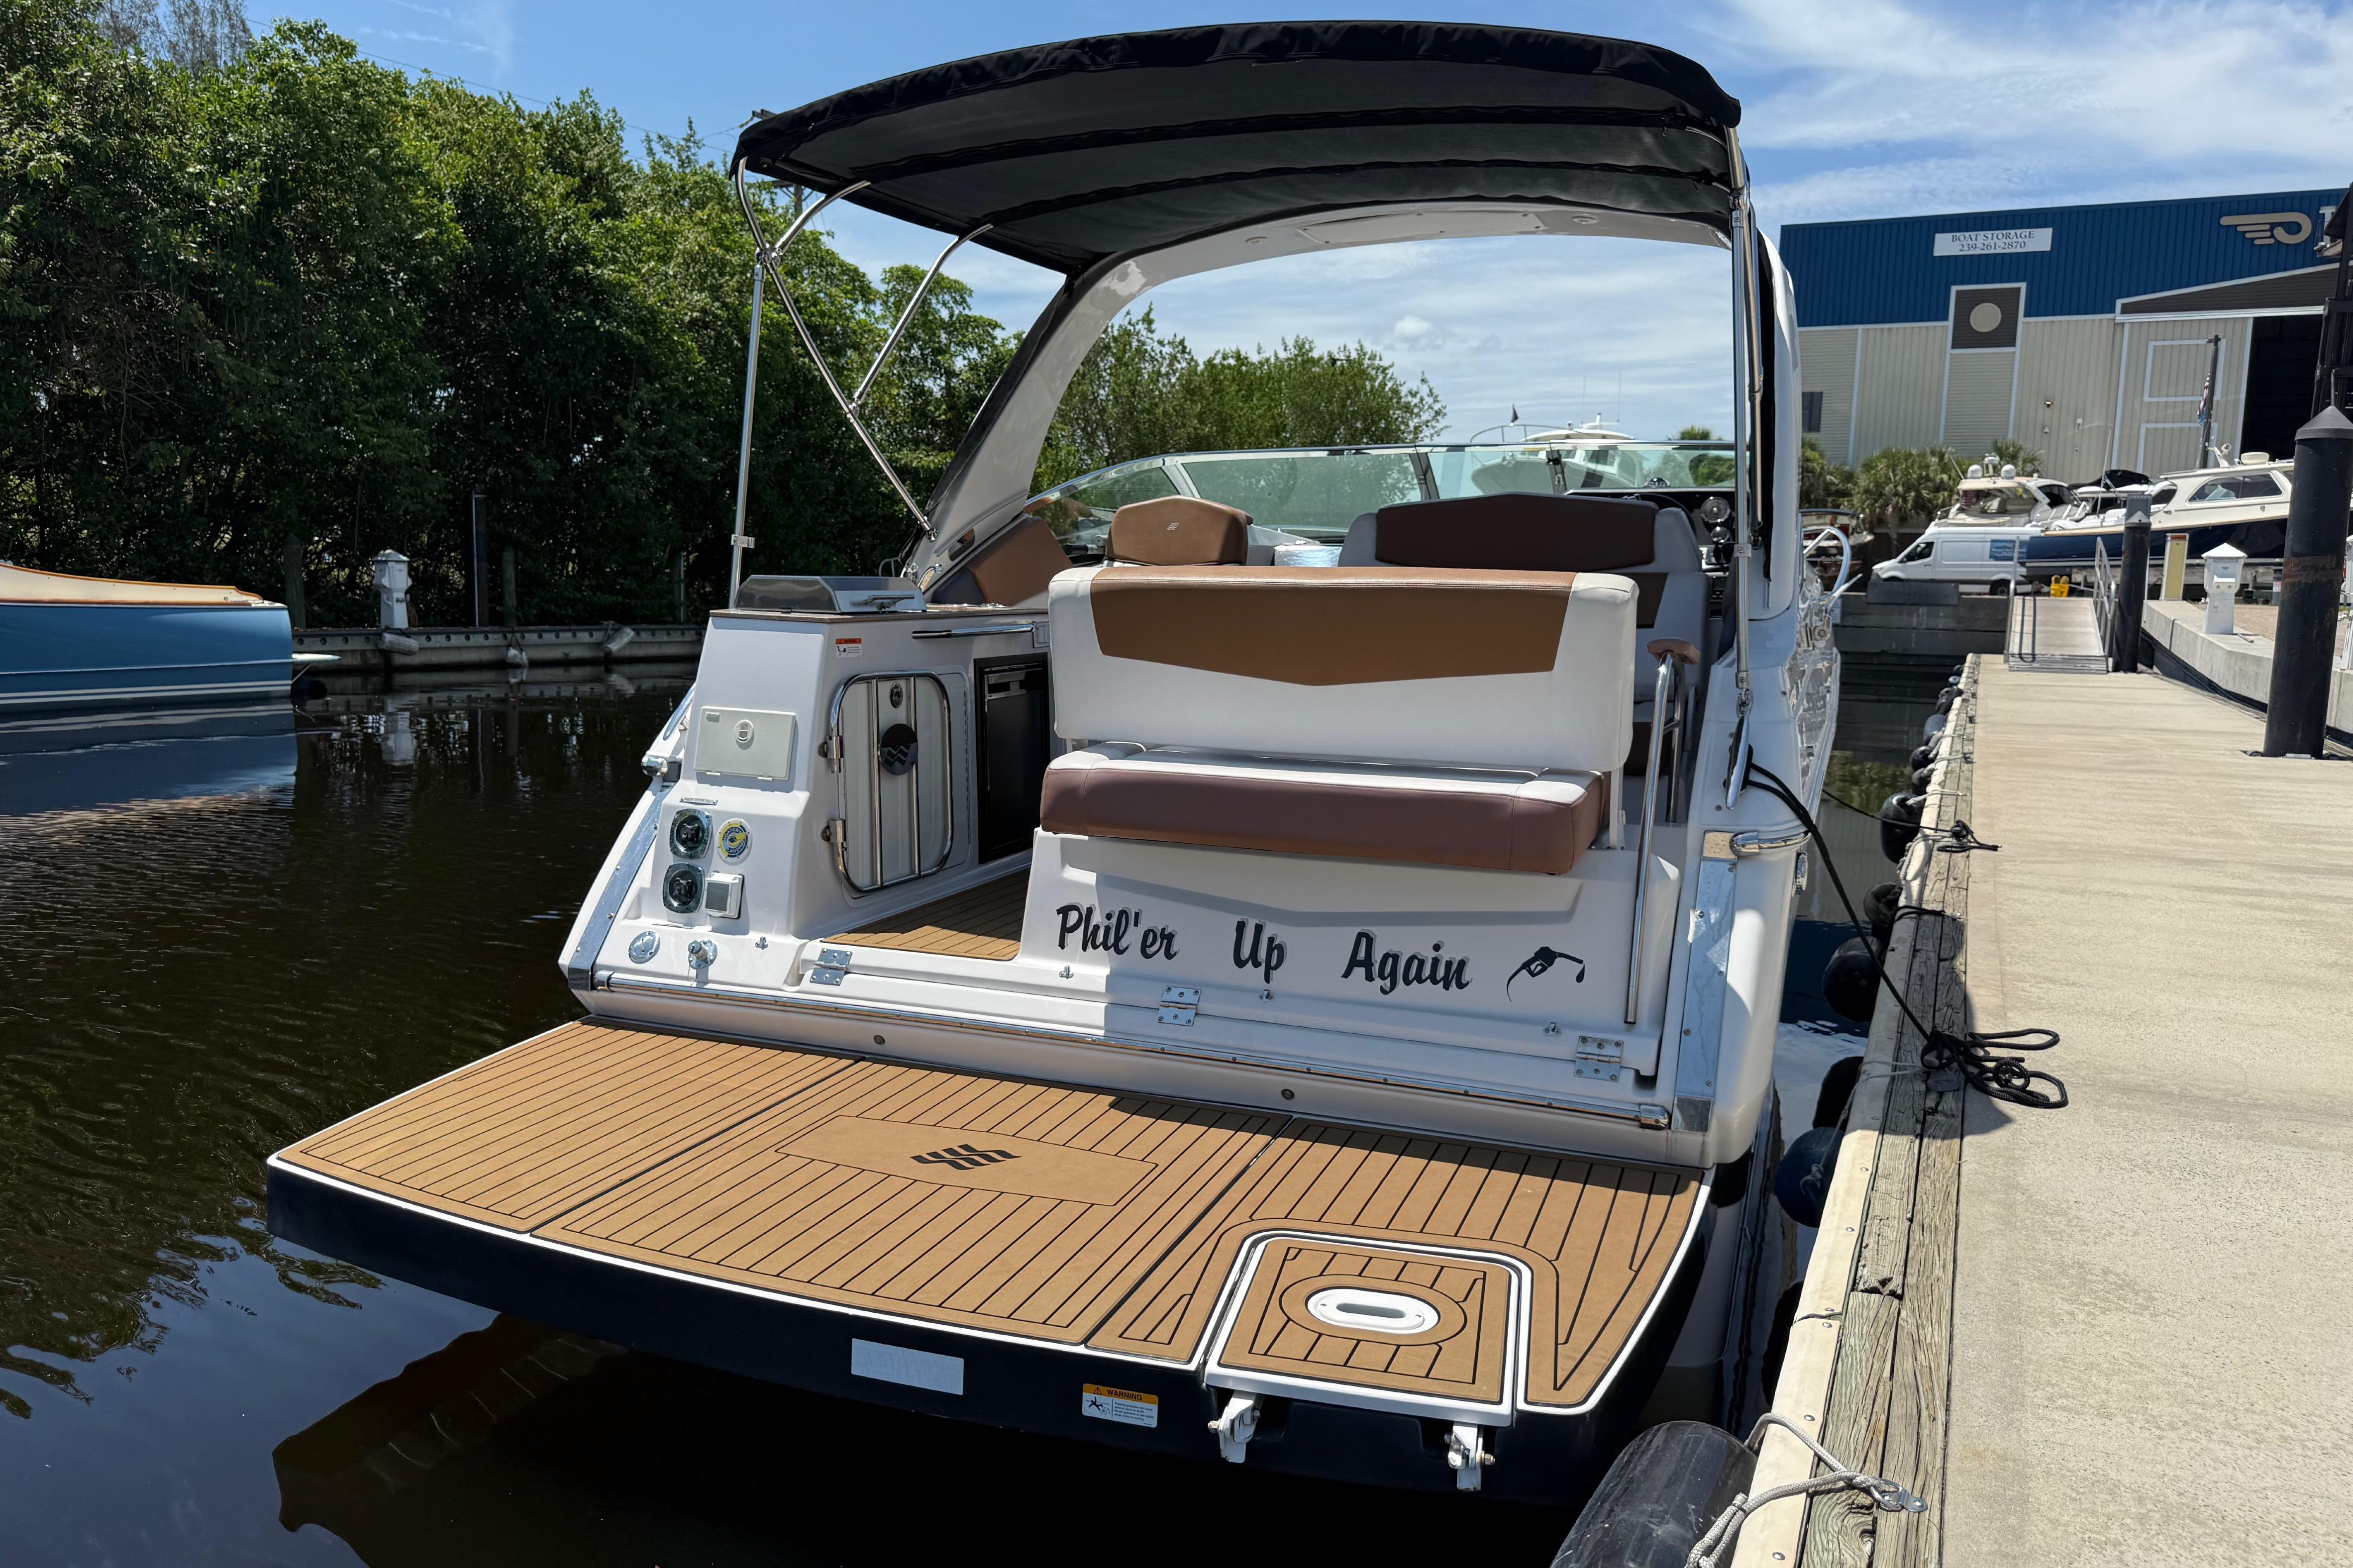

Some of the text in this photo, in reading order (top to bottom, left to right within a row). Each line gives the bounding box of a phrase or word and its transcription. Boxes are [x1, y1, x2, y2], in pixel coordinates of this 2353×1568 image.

[1951, 230, 2035, 242] BOAT STORAGE
[1959, 240, 2026, 252] 239-261-2870
[1056, 902, 1473, 995] Phil'er Up Again
[1107, 1388, 1142, 1400] WARNING
